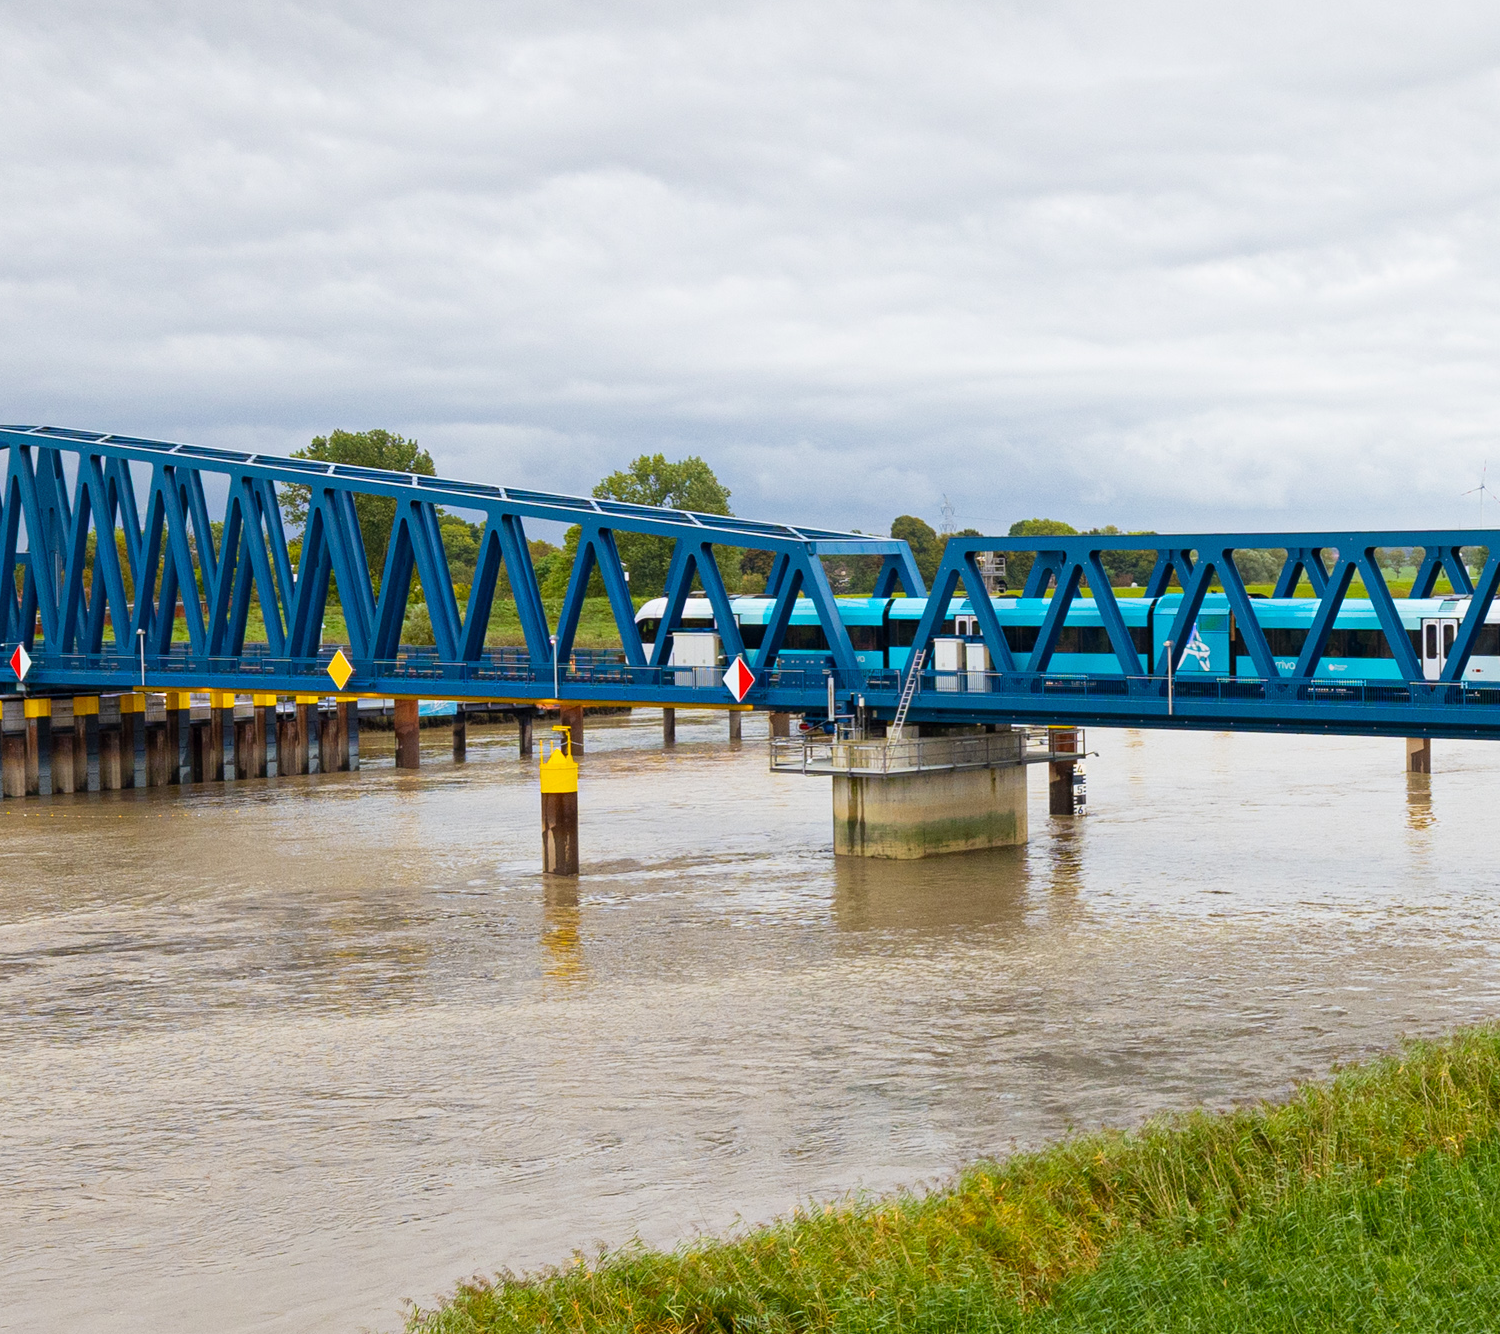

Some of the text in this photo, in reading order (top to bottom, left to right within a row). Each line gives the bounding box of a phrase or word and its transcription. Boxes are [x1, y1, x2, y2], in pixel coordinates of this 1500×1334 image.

[1077, 765, 1083, 773] 4
[1077, 786, 1083, 794] 5
[1078, 806, 1083, 814] 6
